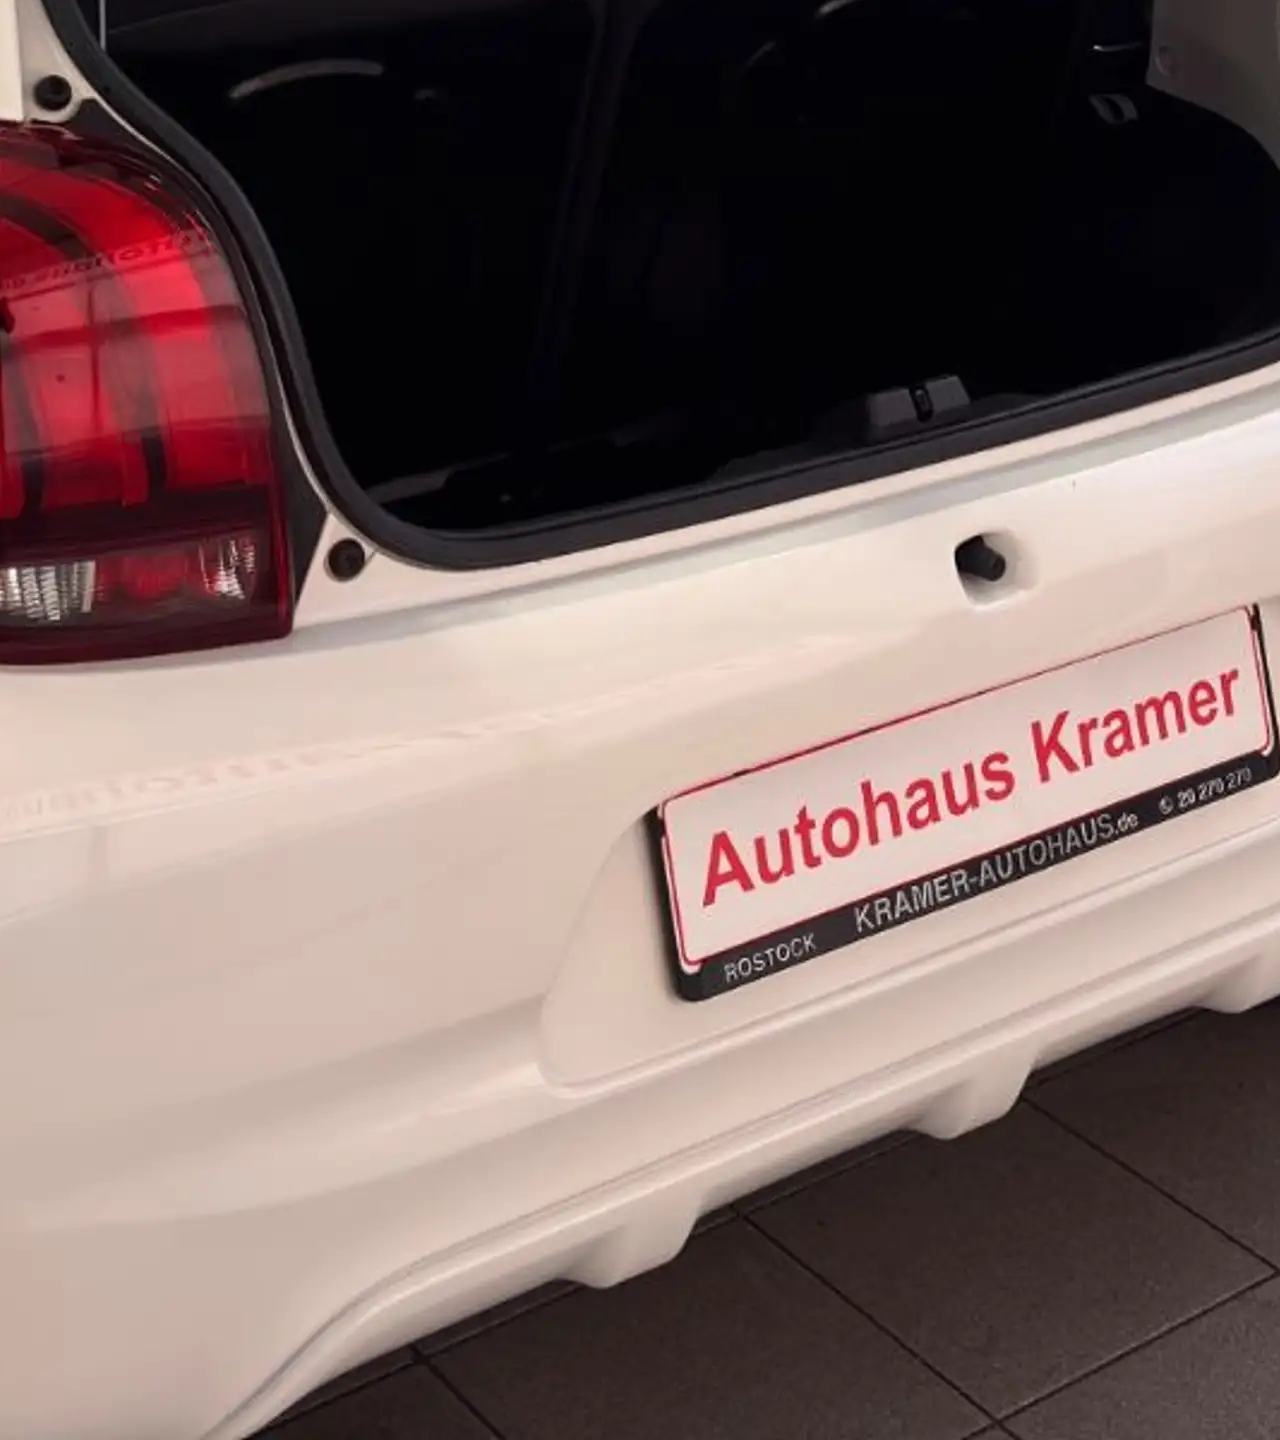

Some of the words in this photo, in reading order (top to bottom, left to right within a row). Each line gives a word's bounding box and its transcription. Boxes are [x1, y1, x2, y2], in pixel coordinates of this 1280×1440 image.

[702, 751, 1016, 908] Autohaus
[1030, 668, 1240, 783] Kramer
[724, 932, 818, 982] ROSTOCK
[853, 810, 1139, 933] KRAMER-AUTOHAUS.de
[1177, 787, 1196, 809] 20
[1199, 777, 1225, 800] 270
